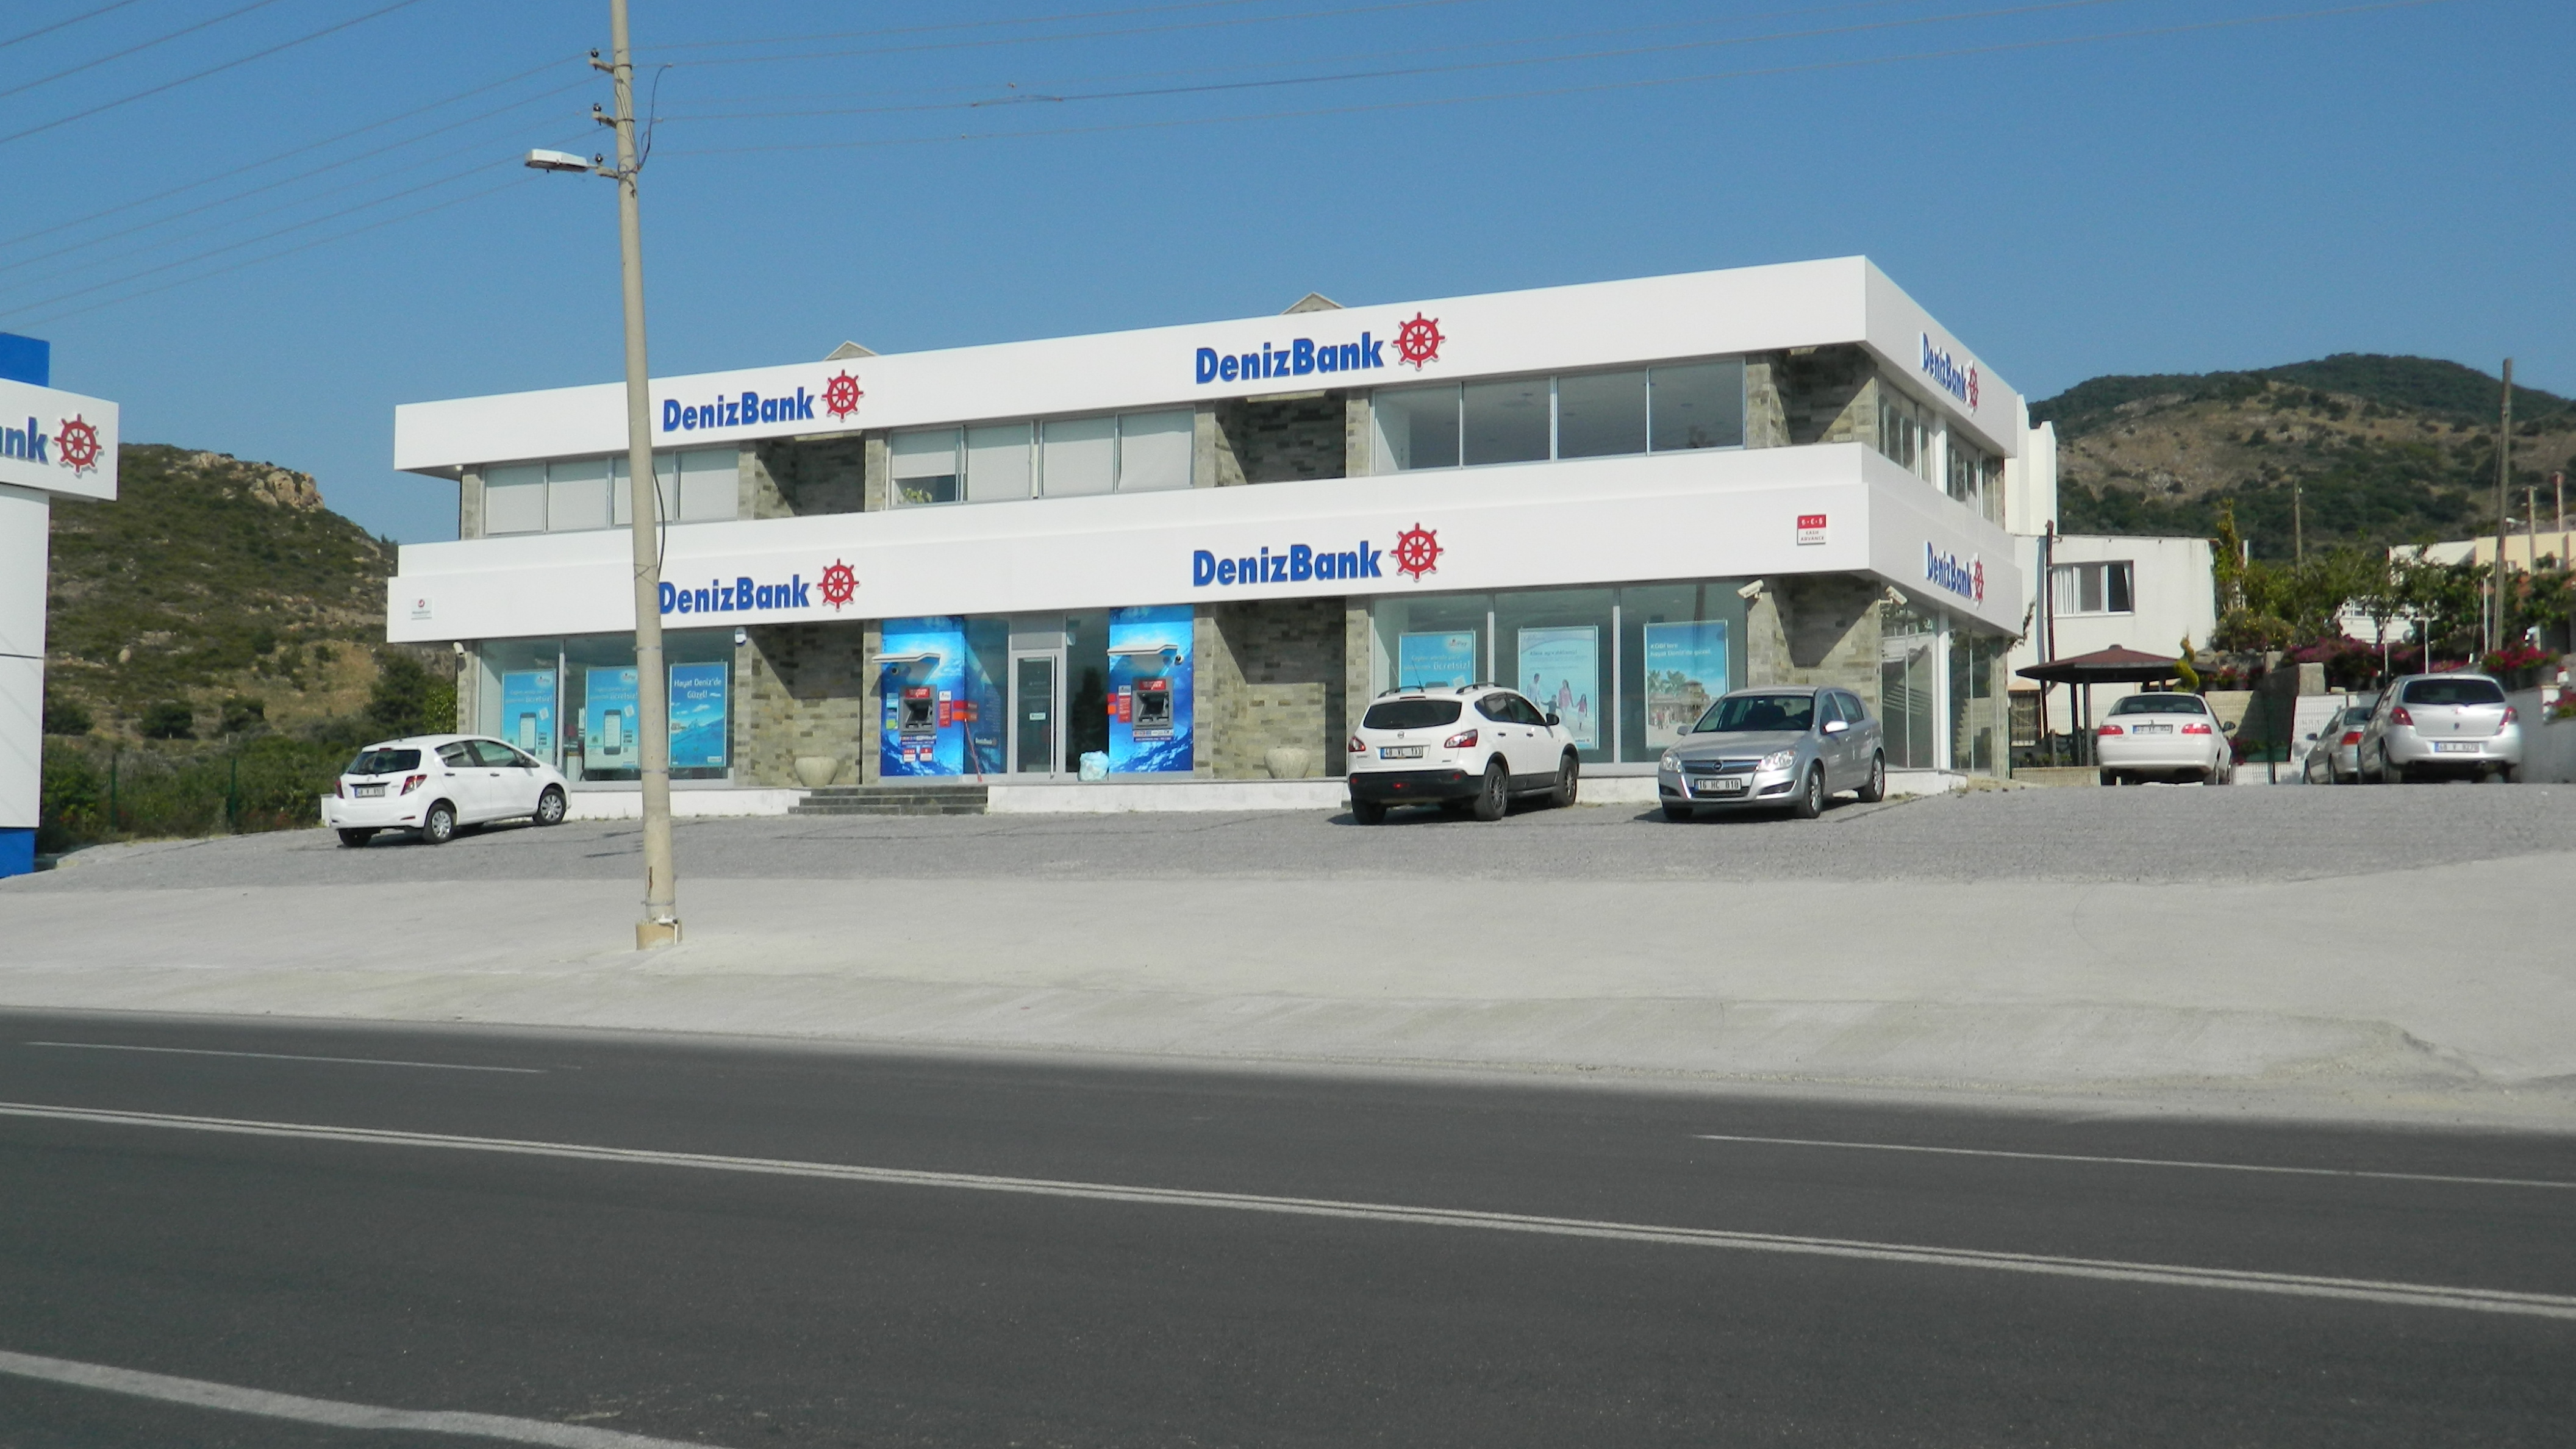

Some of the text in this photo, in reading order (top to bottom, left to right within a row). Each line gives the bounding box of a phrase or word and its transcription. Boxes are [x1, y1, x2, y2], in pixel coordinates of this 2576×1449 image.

[1196, 332, 1384, 384] DenizBank
[1922, 332, 1966, 403] DenizBank
[663, 387, 815, 432] DenizBank
[0, 416, 49, 465] nk
[1193, 540, 1382, 587] DenizBank
[1927, 543, 1972, 599] DenizBank
[659, 574, 810, 614] DenizBank
[674, 677, 721, 688] Hayat Deniz'de
